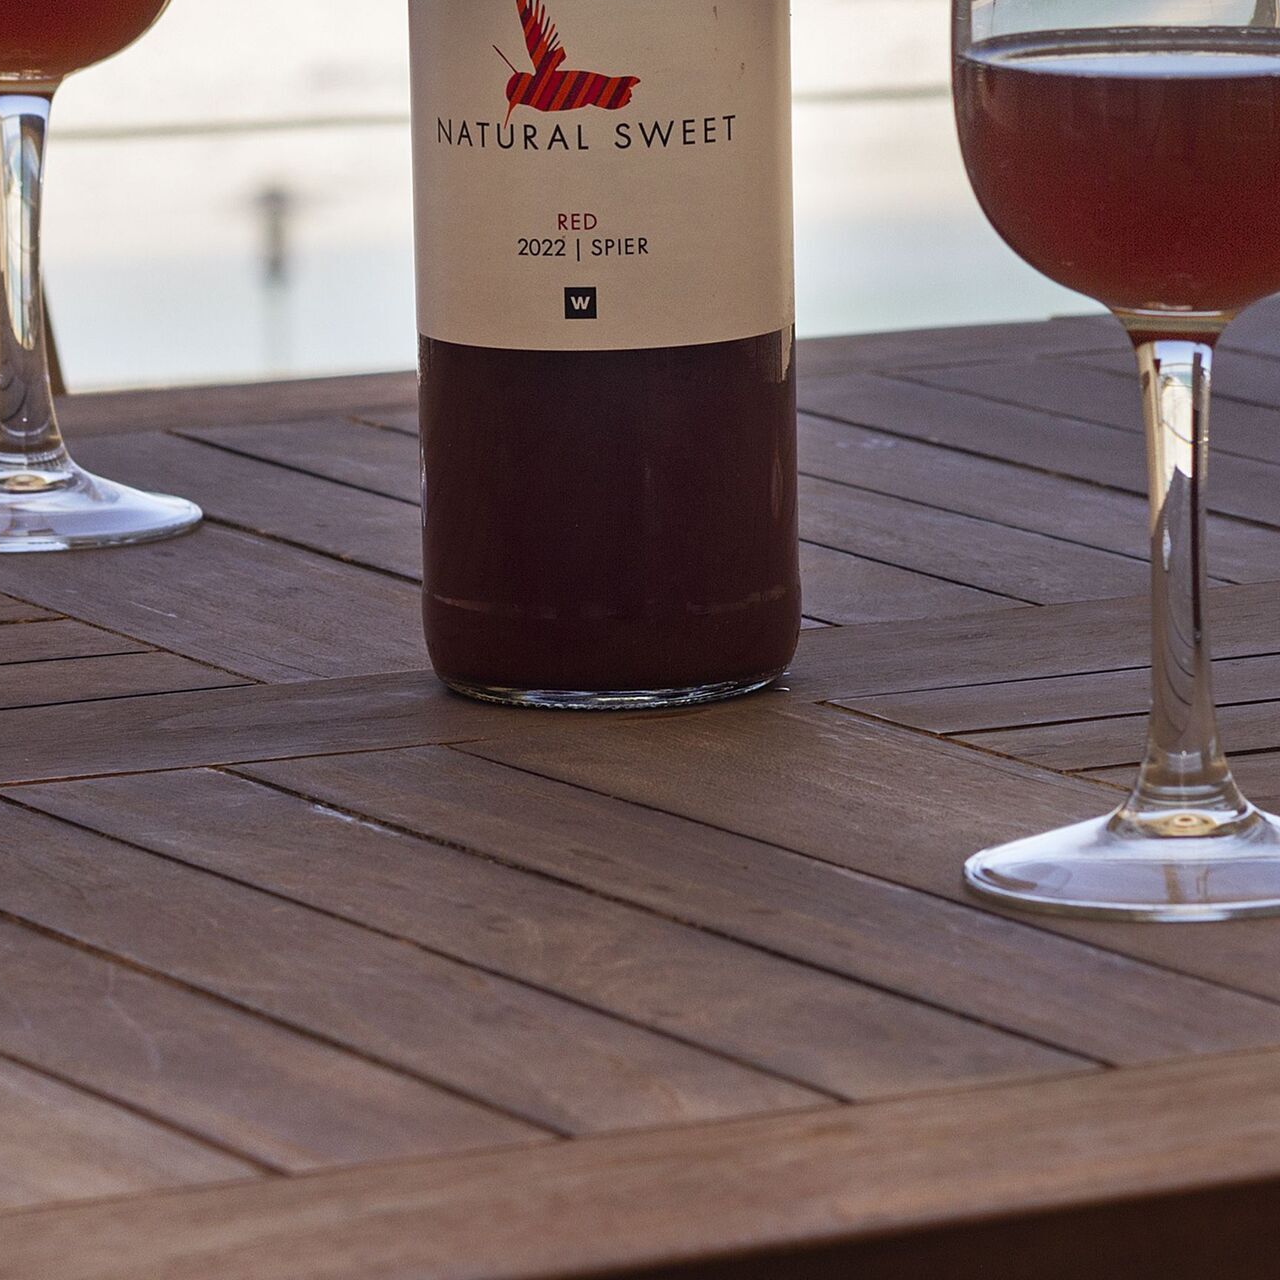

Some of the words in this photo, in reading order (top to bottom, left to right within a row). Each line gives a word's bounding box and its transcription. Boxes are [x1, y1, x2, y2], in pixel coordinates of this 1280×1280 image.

[437, 116, 590, 151] NATURAL
[614, 114, 737, 150] SWEET
[557, 213, 598, 231] RED
[517, 238, 567, 257] 2022
[591, 237, 649, 257] SPIER
